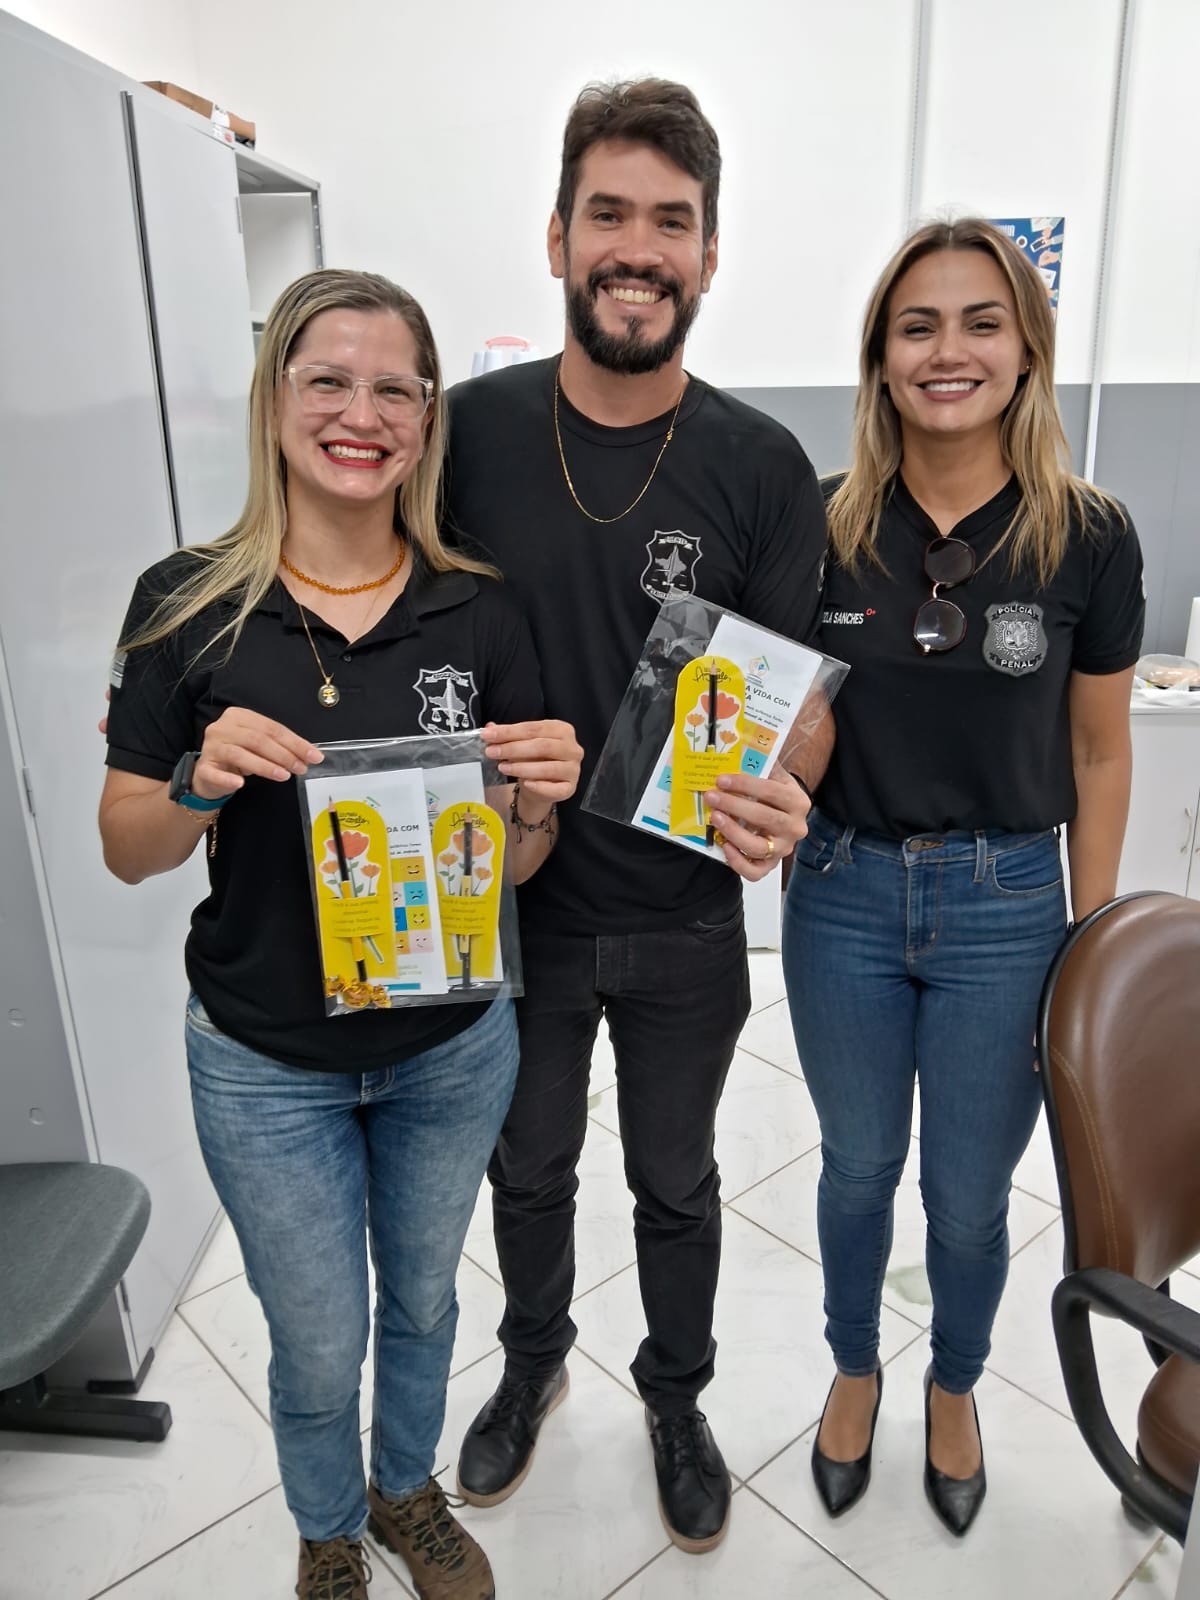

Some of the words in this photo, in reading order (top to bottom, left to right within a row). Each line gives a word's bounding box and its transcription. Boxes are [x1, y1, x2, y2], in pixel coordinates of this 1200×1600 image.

[997, 604, 1034, 616] POLÍCIA
[833, 611, 864, 625] SANCHES
[1000, 660, 1034, 669] PENAL
[753, 687, 772, 701] VIDA
[773, 697, 791, 709] COM
[400, 824, 420, 832] COM
